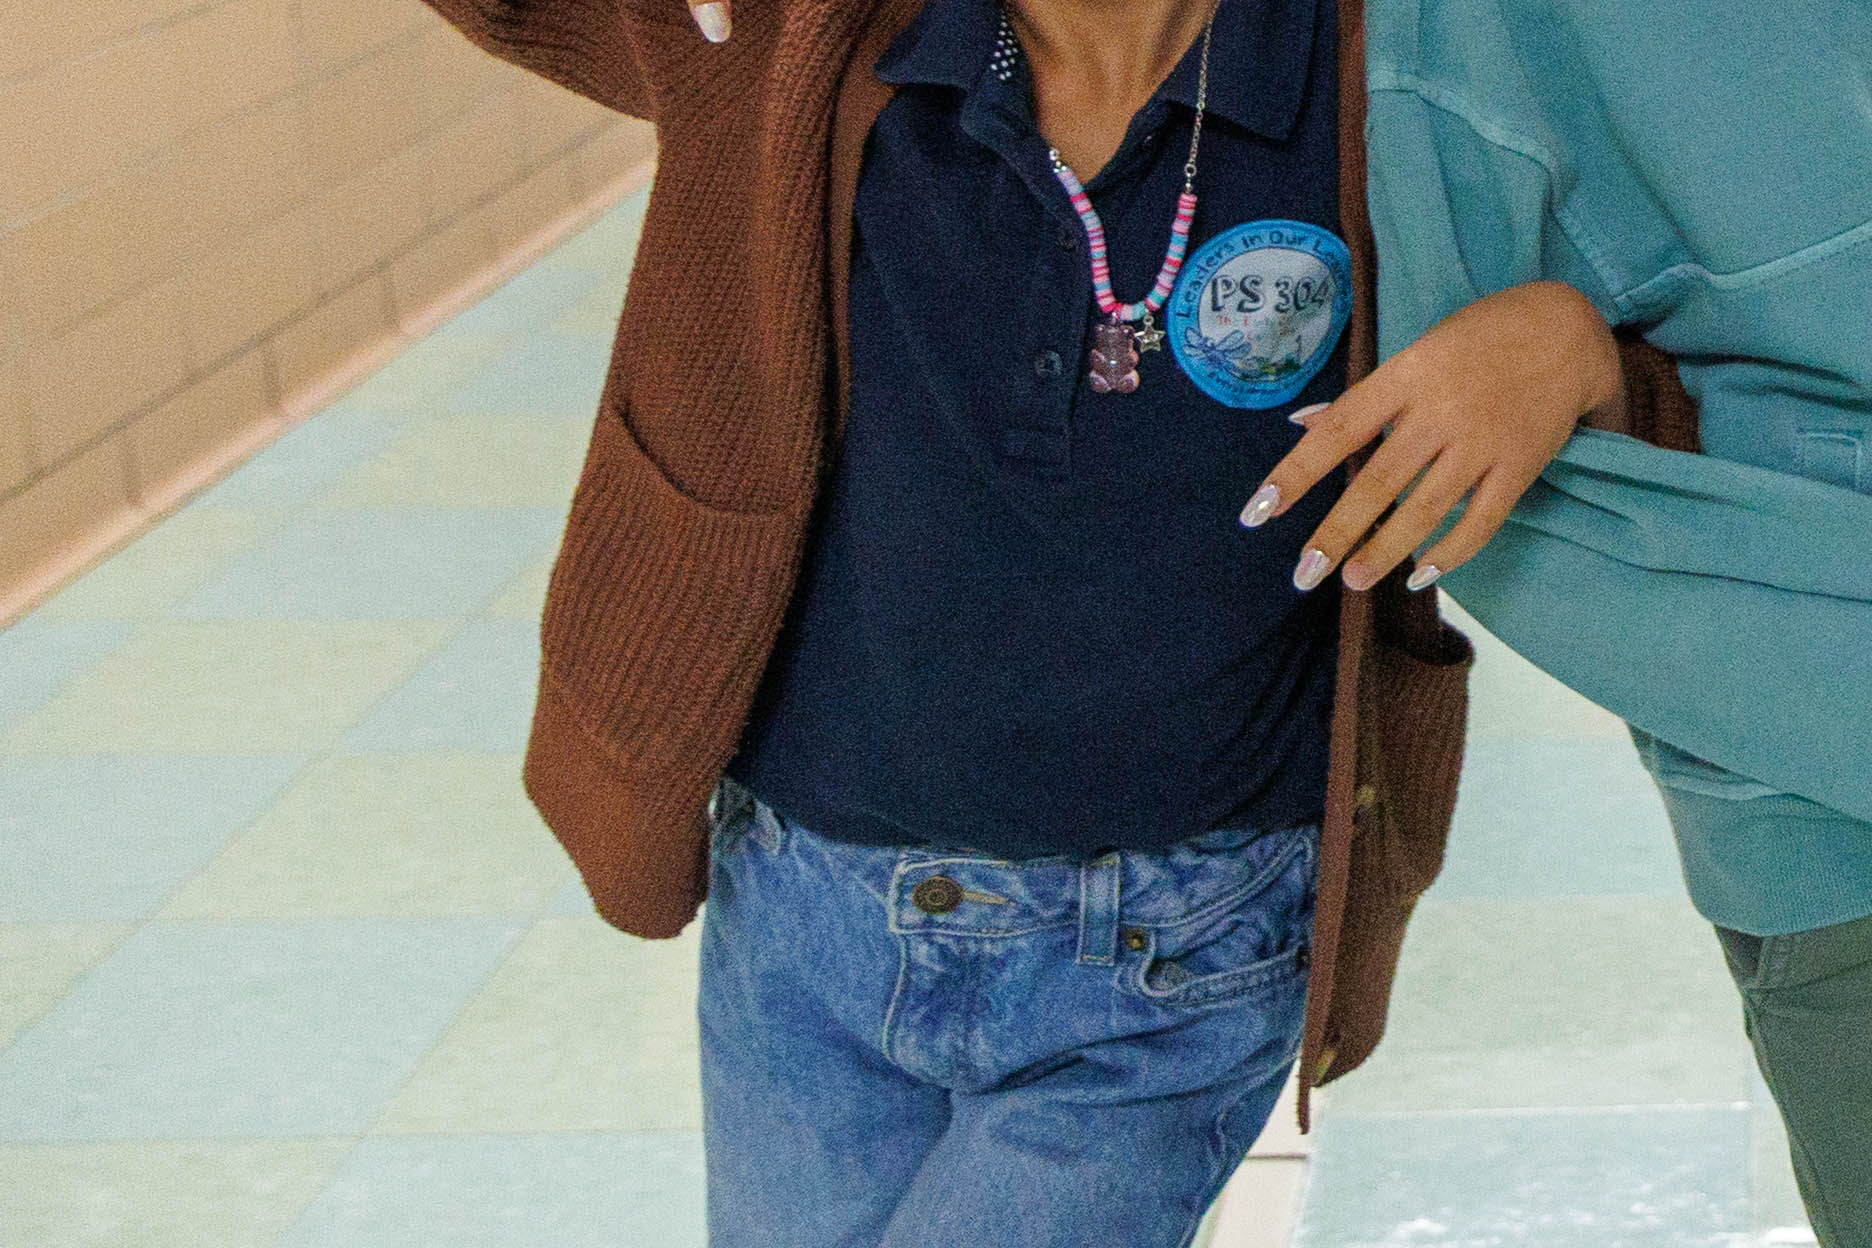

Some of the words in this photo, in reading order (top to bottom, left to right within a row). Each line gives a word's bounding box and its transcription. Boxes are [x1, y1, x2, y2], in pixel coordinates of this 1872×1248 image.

[1175, 241, 1235, 319] Leaders
[1269, 230, 1307, 247] Our
[1210, 273, 1265, 313] PS
[1273, 273, 1331, 314] 304
